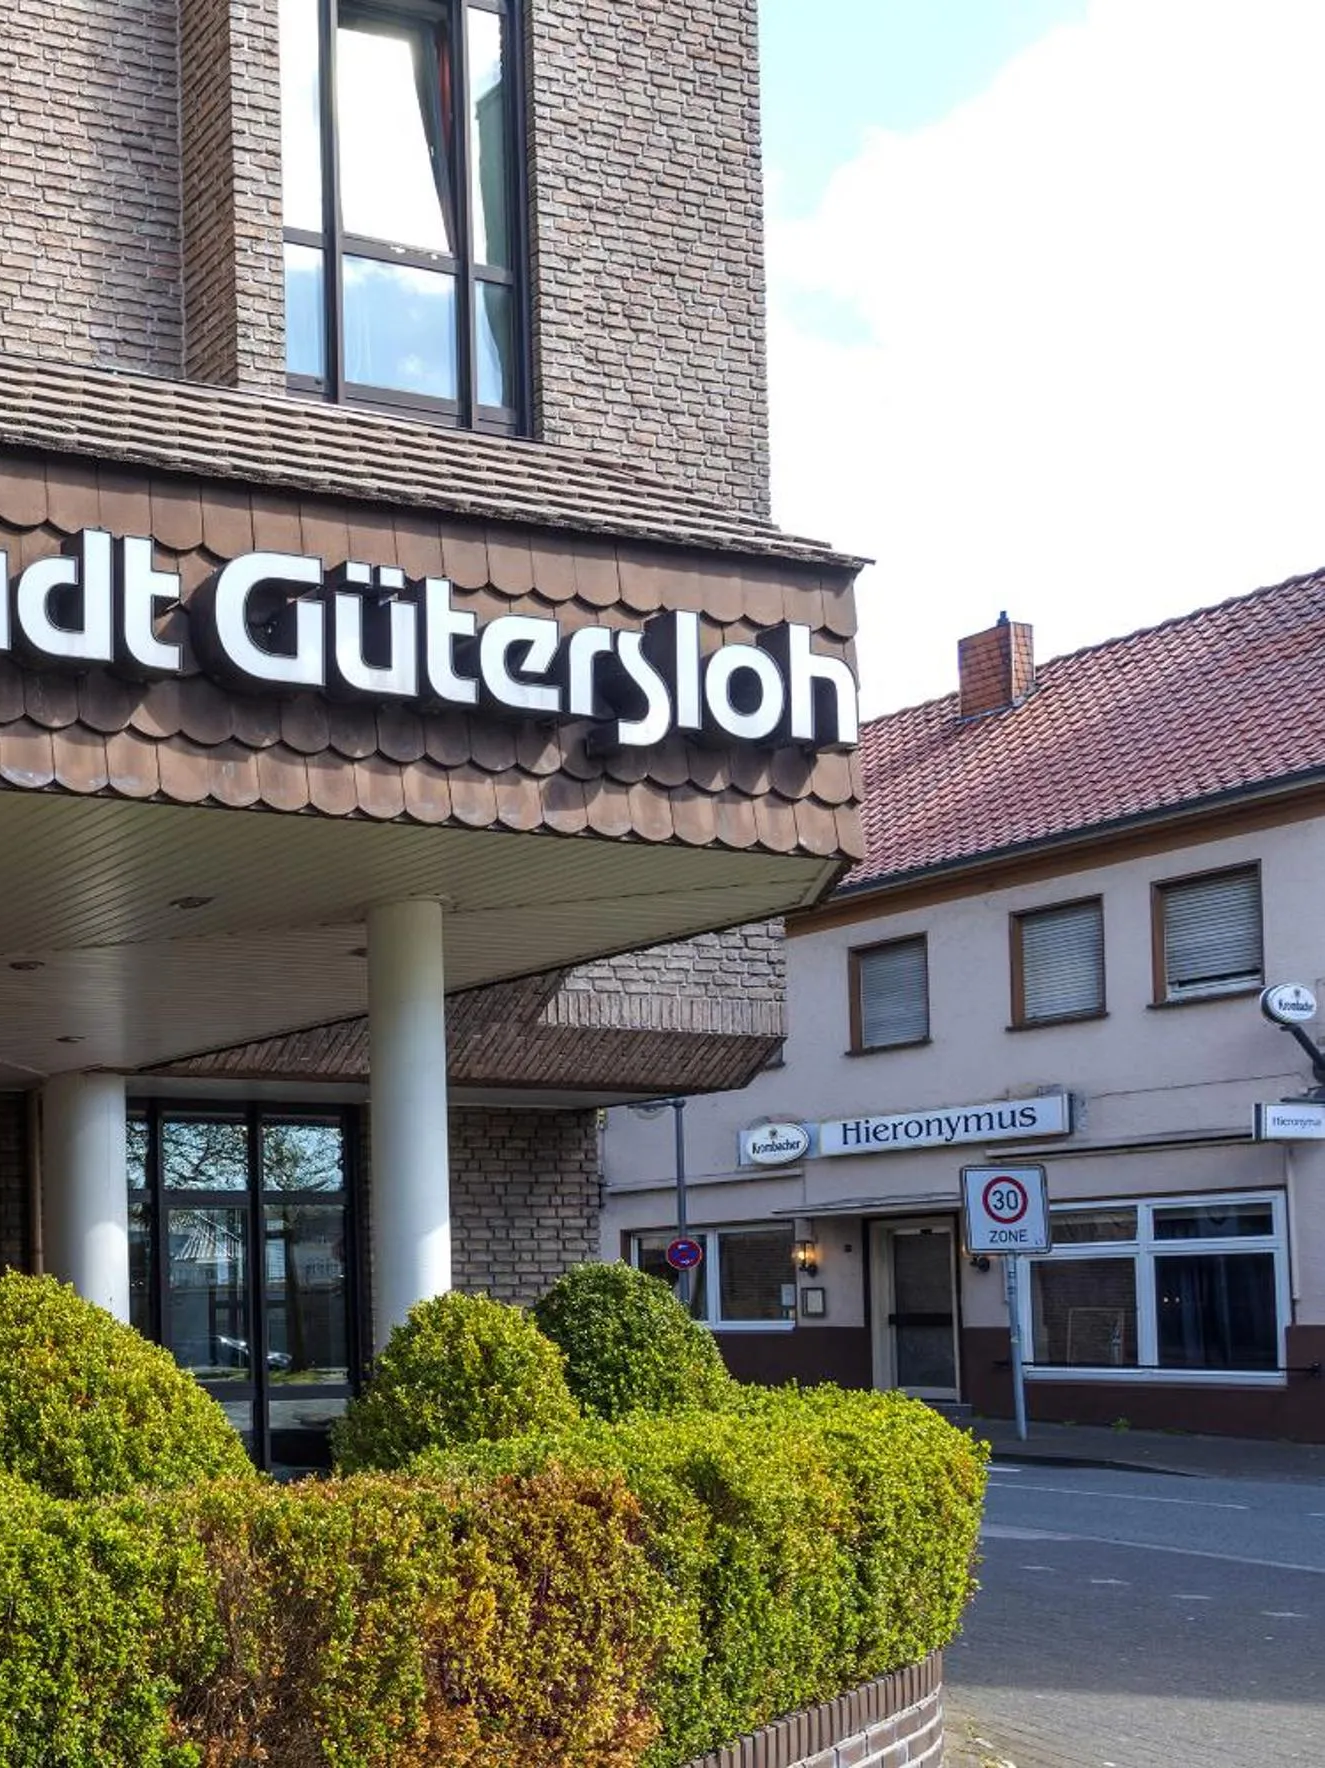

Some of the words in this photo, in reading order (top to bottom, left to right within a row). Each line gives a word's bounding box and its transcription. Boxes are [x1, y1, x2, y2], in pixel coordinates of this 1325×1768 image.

[214, 551, 859, 747] Gütersloh
[842, 1106, 1037, 1145] Hieronymus
[752, 1139, 801, 1154] Krombacher
[992, 1189, 1019, 1211] 30
[989, 1229, 1028, 1243] ZONE
